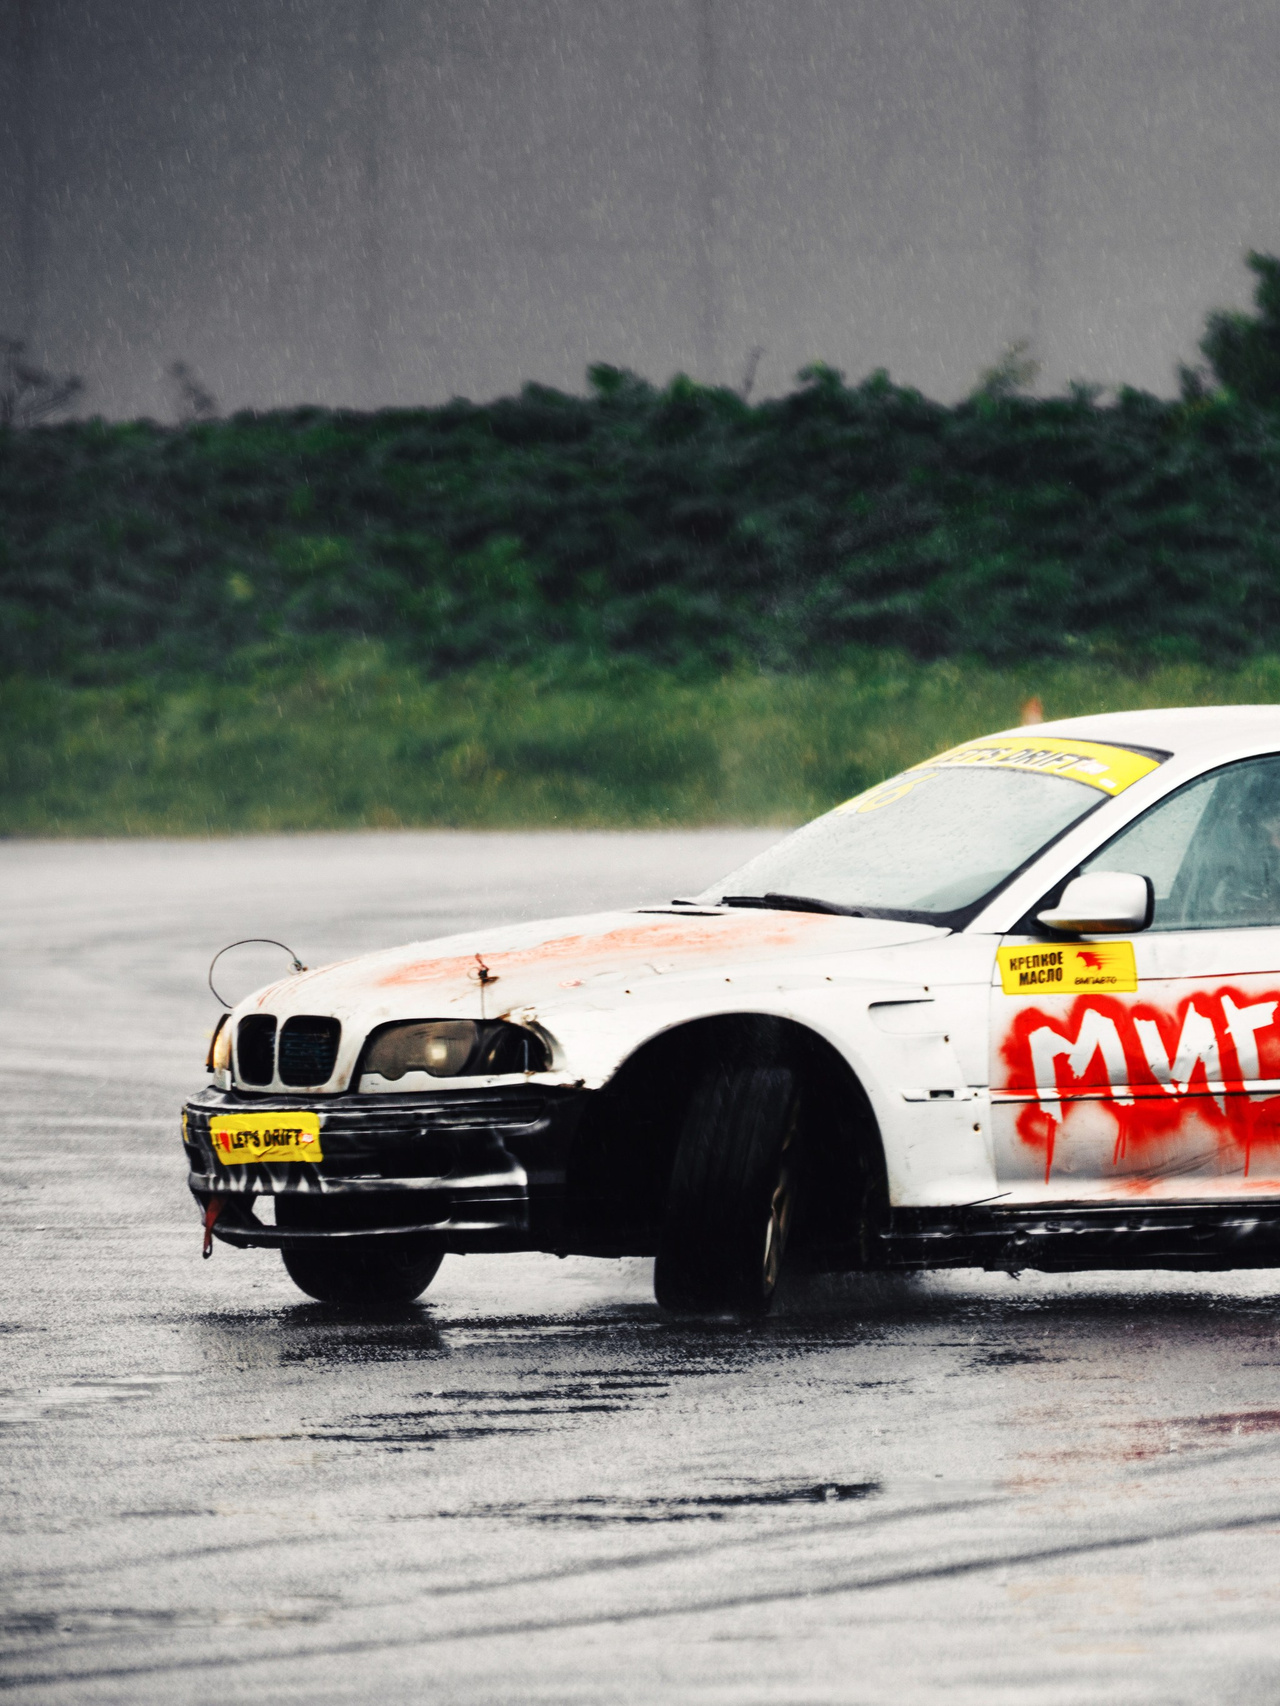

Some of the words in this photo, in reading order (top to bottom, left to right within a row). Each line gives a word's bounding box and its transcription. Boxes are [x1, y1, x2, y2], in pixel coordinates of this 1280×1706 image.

[998, 748, 1093, 770] DRIFT
[1009, 951, 1064, 971] КРЕПКОЕ
[1018, 967, 1063, 986] МАСЛО
[230, 1130, 261, 1149] LET'S
[263, 1128, 303, 1148] DRIFT
